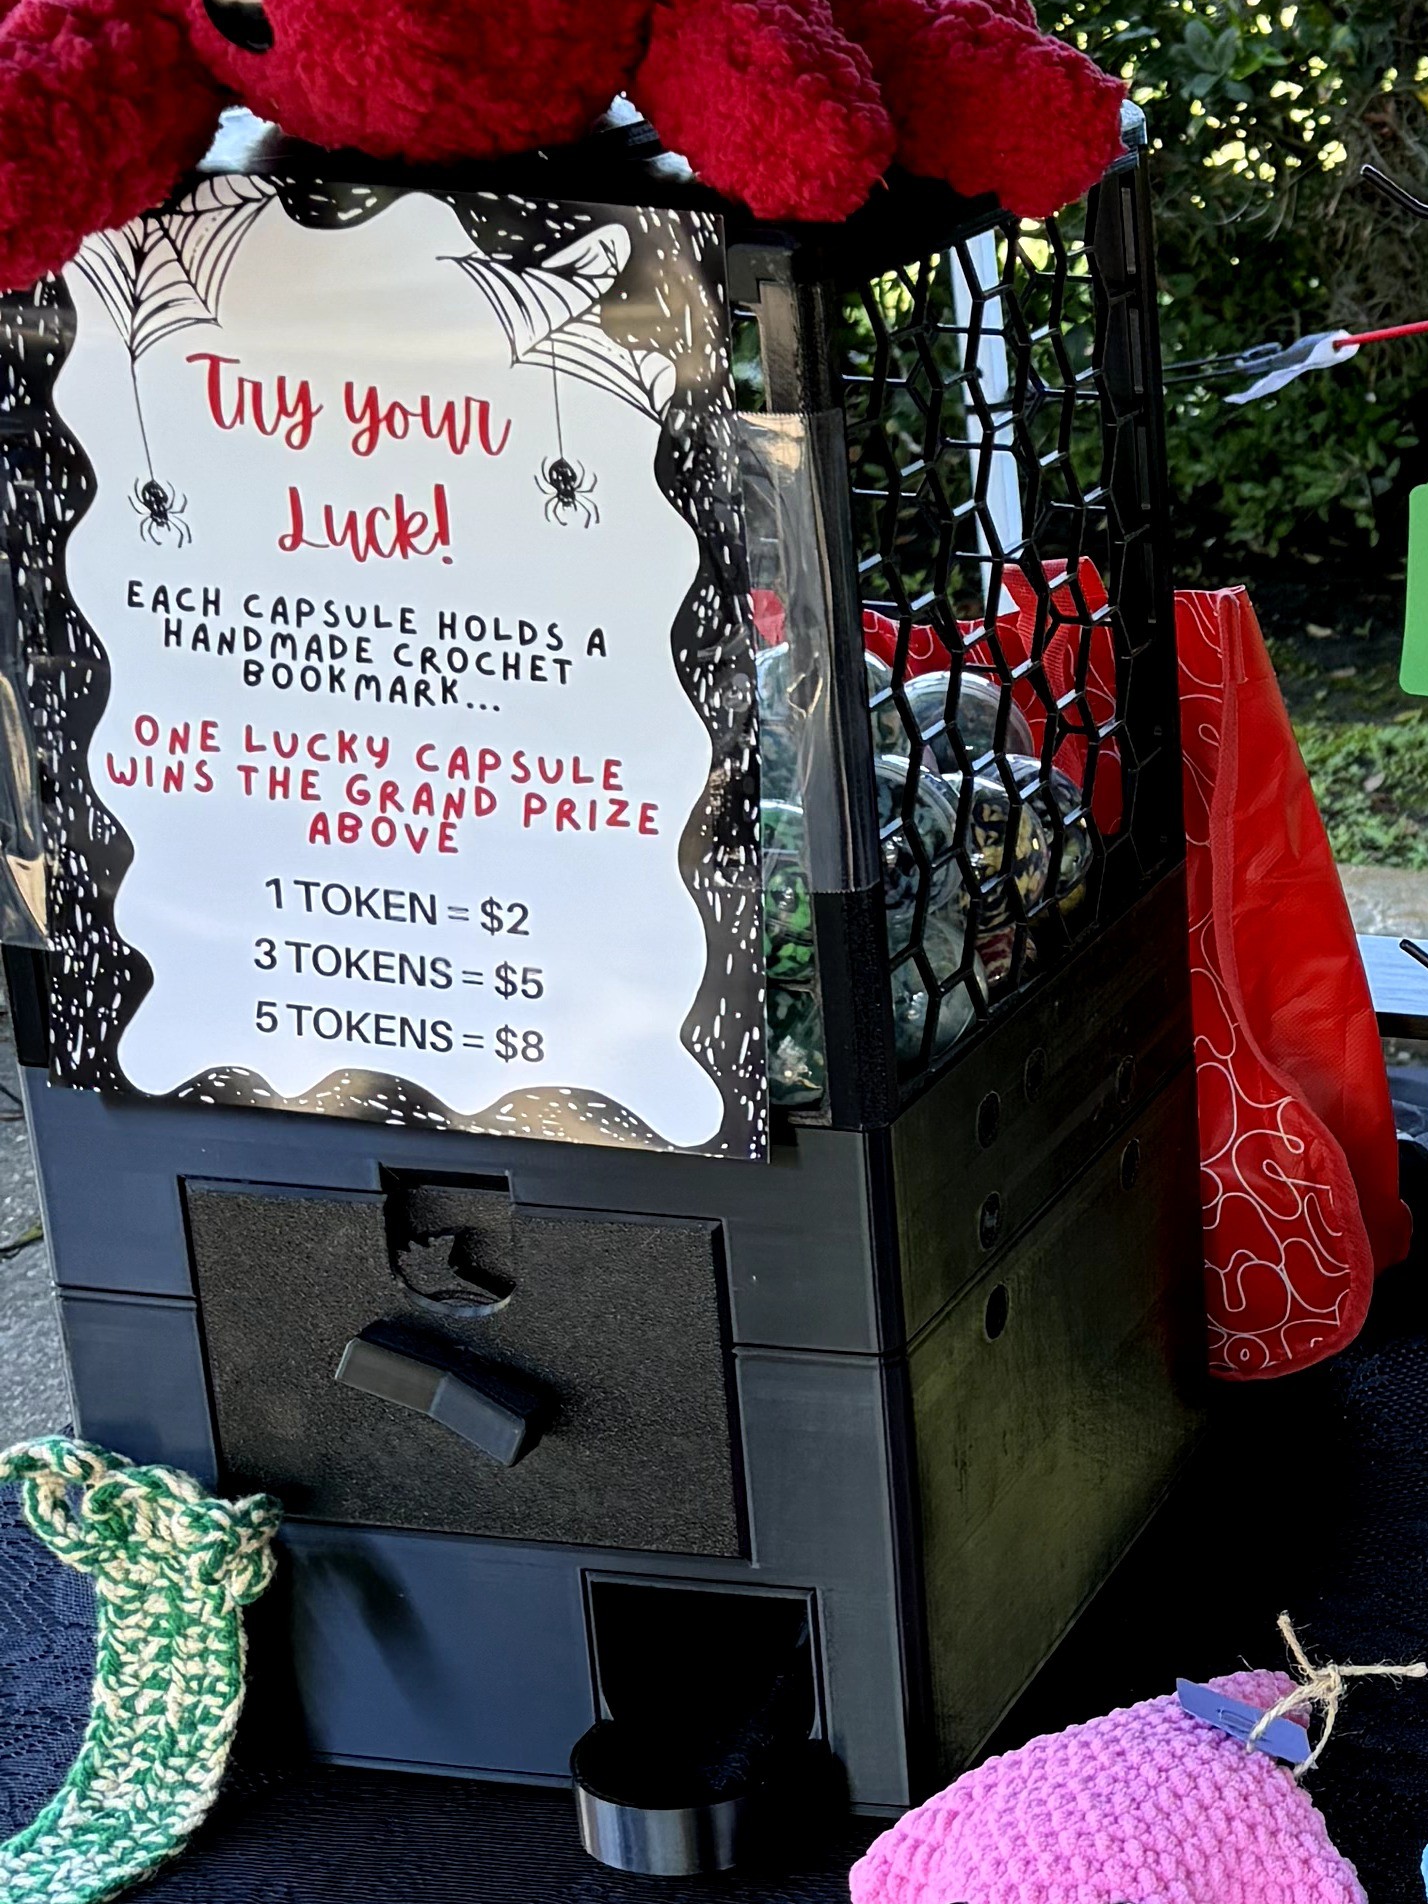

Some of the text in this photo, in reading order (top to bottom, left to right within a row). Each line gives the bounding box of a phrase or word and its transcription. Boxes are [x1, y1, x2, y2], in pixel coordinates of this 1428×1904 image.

[186, 352, 512, 457] Try your
[278, 483, 453, 565] Luck!
[127, 579, 607, 658] EACH CAPSULE HOLDS A
[164, 617, 573, 685] HANDMADE CROCHET
[243, 658, 500, 712] BOOKMARK...
[134, 714, 623, 792] ONE LUCKY CAPSULE
[106, 752, 659, 835] WINS THE GRAND PRIZE
[308, 811, 459, 855] ABOVE
[265, 877, 283, 909] 1
[293, 879, 437, 926] TOKEN
[480, 896, 530, 936] $2
[253, 937, 277, 970] 3
[284, 940, 453, 990] TOKENS
[494, 960, 544, 1001] $5
[255, 1000, 278, 1033] 5
[285, 1003, 453, 1053] TOKENS
[494, 1024, 544, 1063] $8
